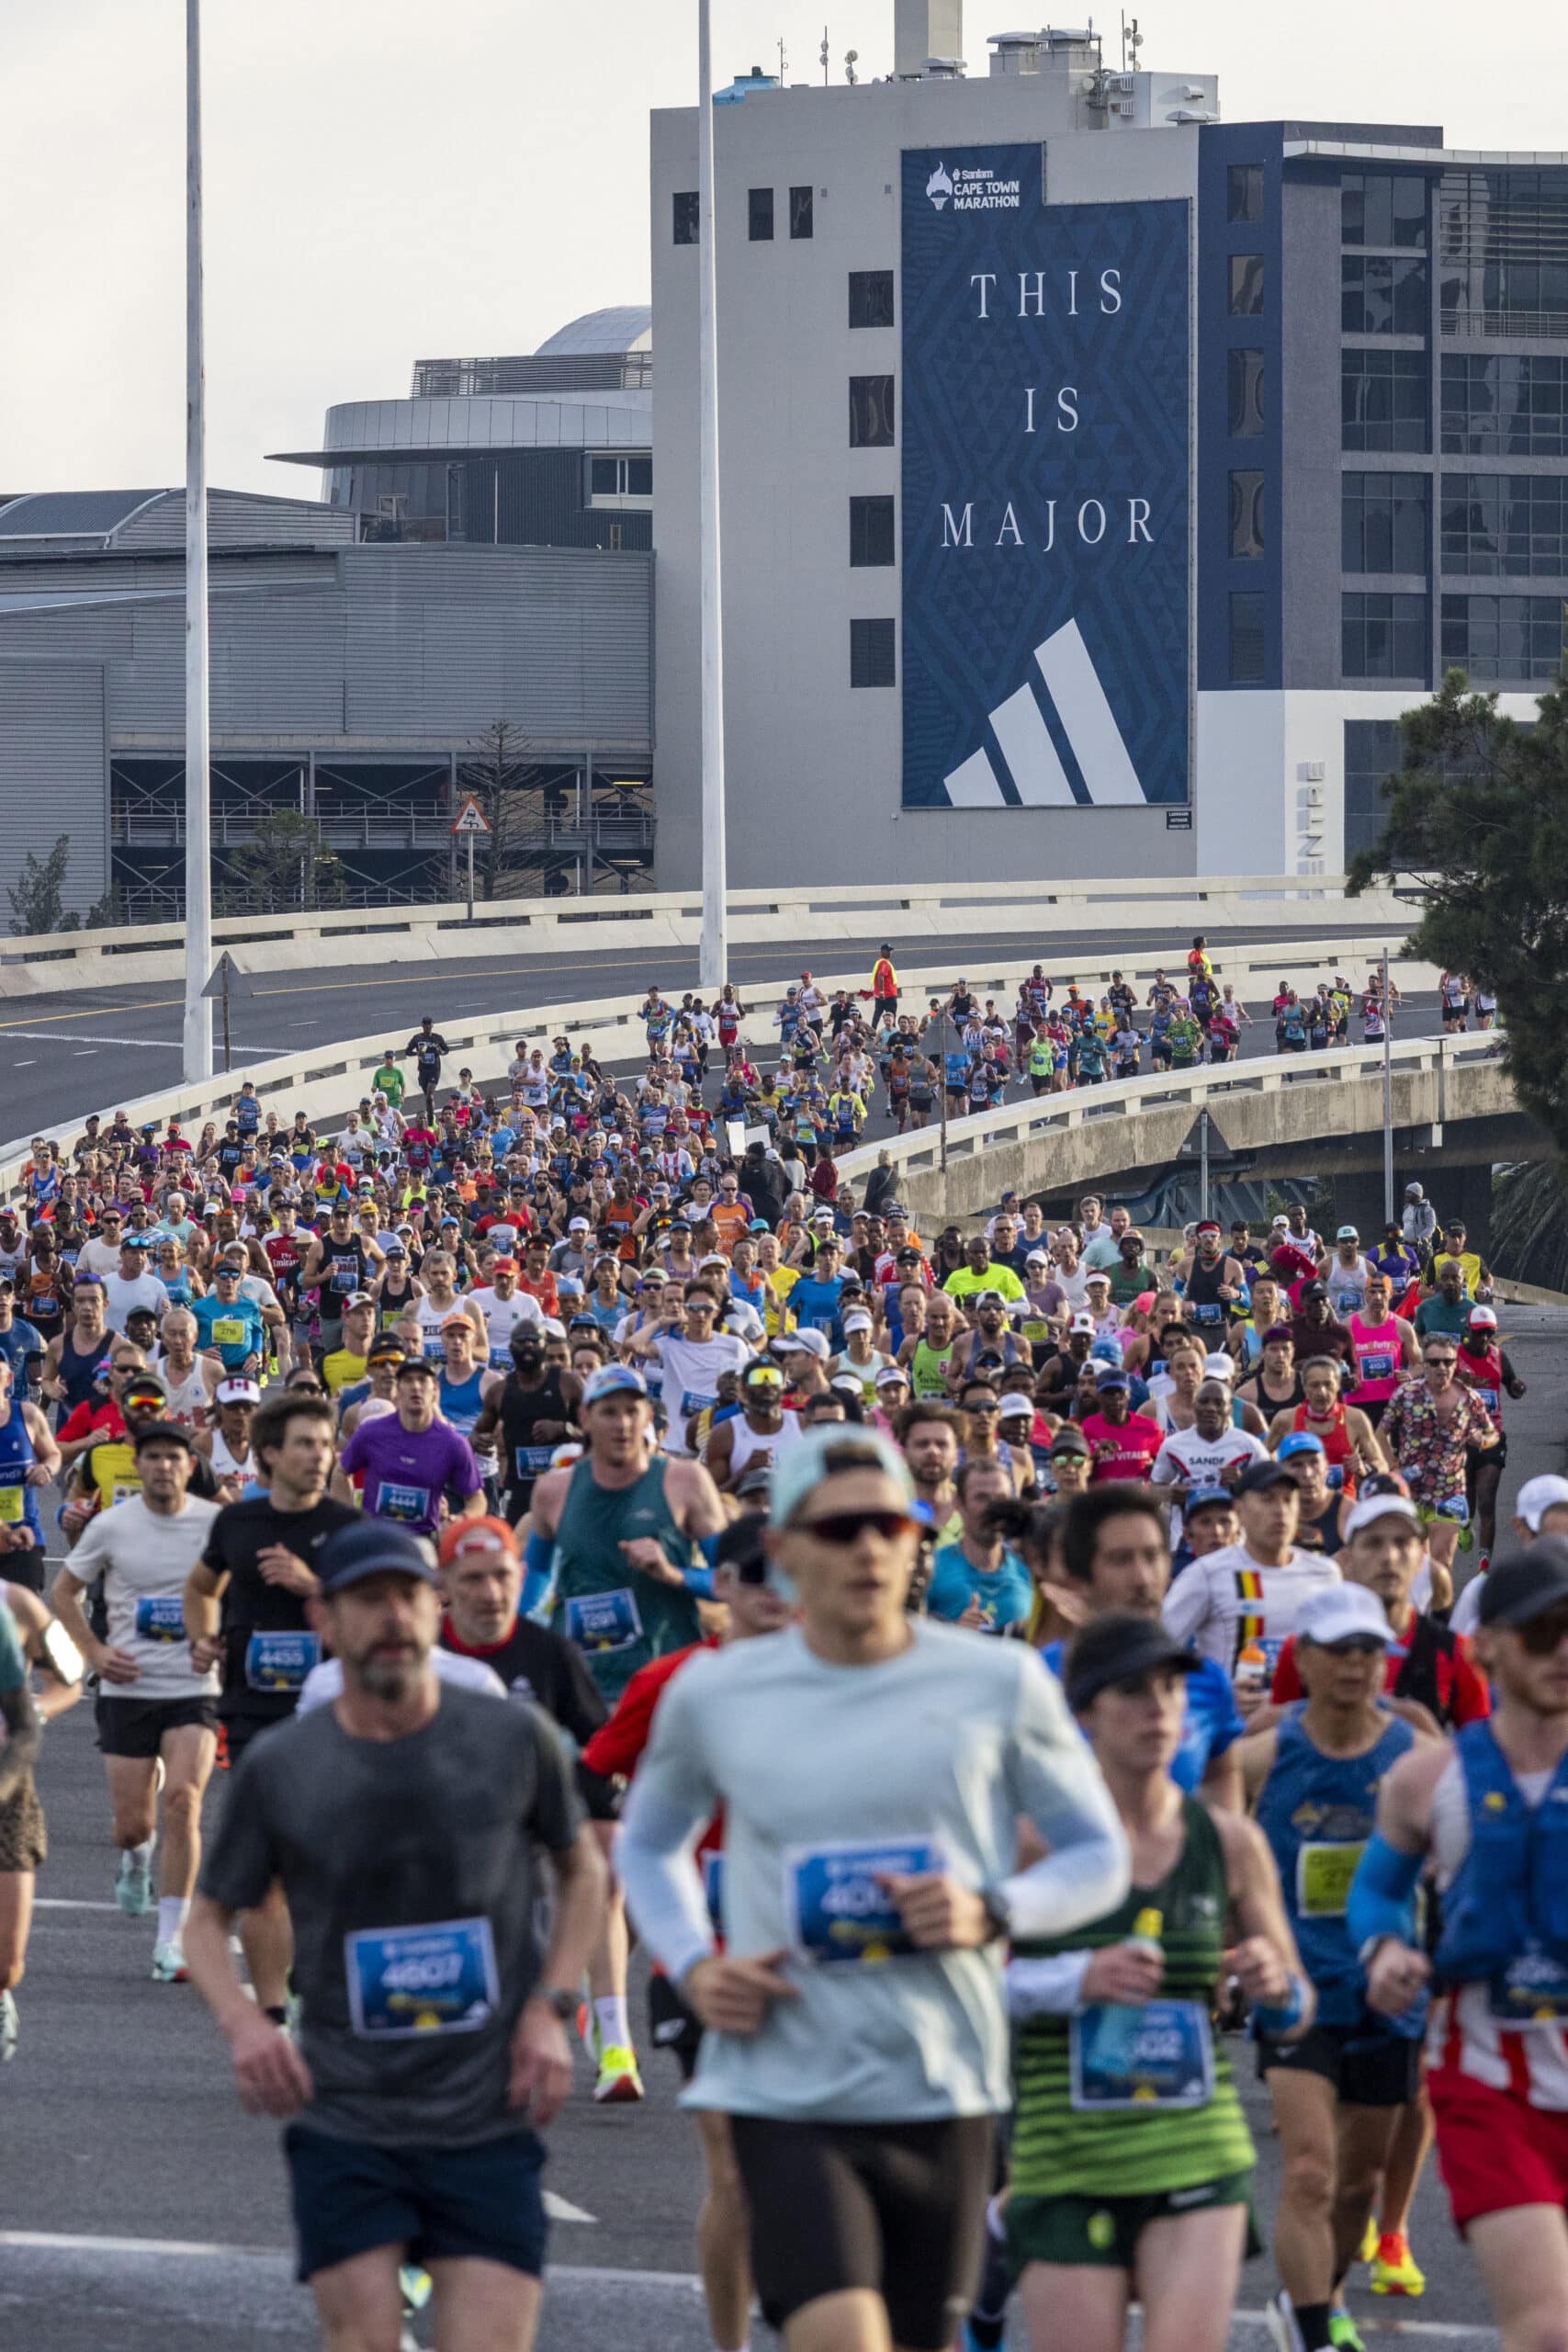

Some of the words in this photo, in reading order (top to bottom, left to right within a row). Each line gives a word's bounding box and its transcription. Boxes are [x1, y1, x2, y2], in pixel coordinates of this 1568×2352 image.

[953, 183, 984, 196] CAPE
[986, 181, 1020, 194] TOWN
[953, 196, 1020, 210] MARATHON
[970, 268, 1123, 319] THIS
[1023, 387, 1080, 433] IS
[940, 498, 1155, 552] MAJOR
[389, 1495, 416, 1507] 4444
